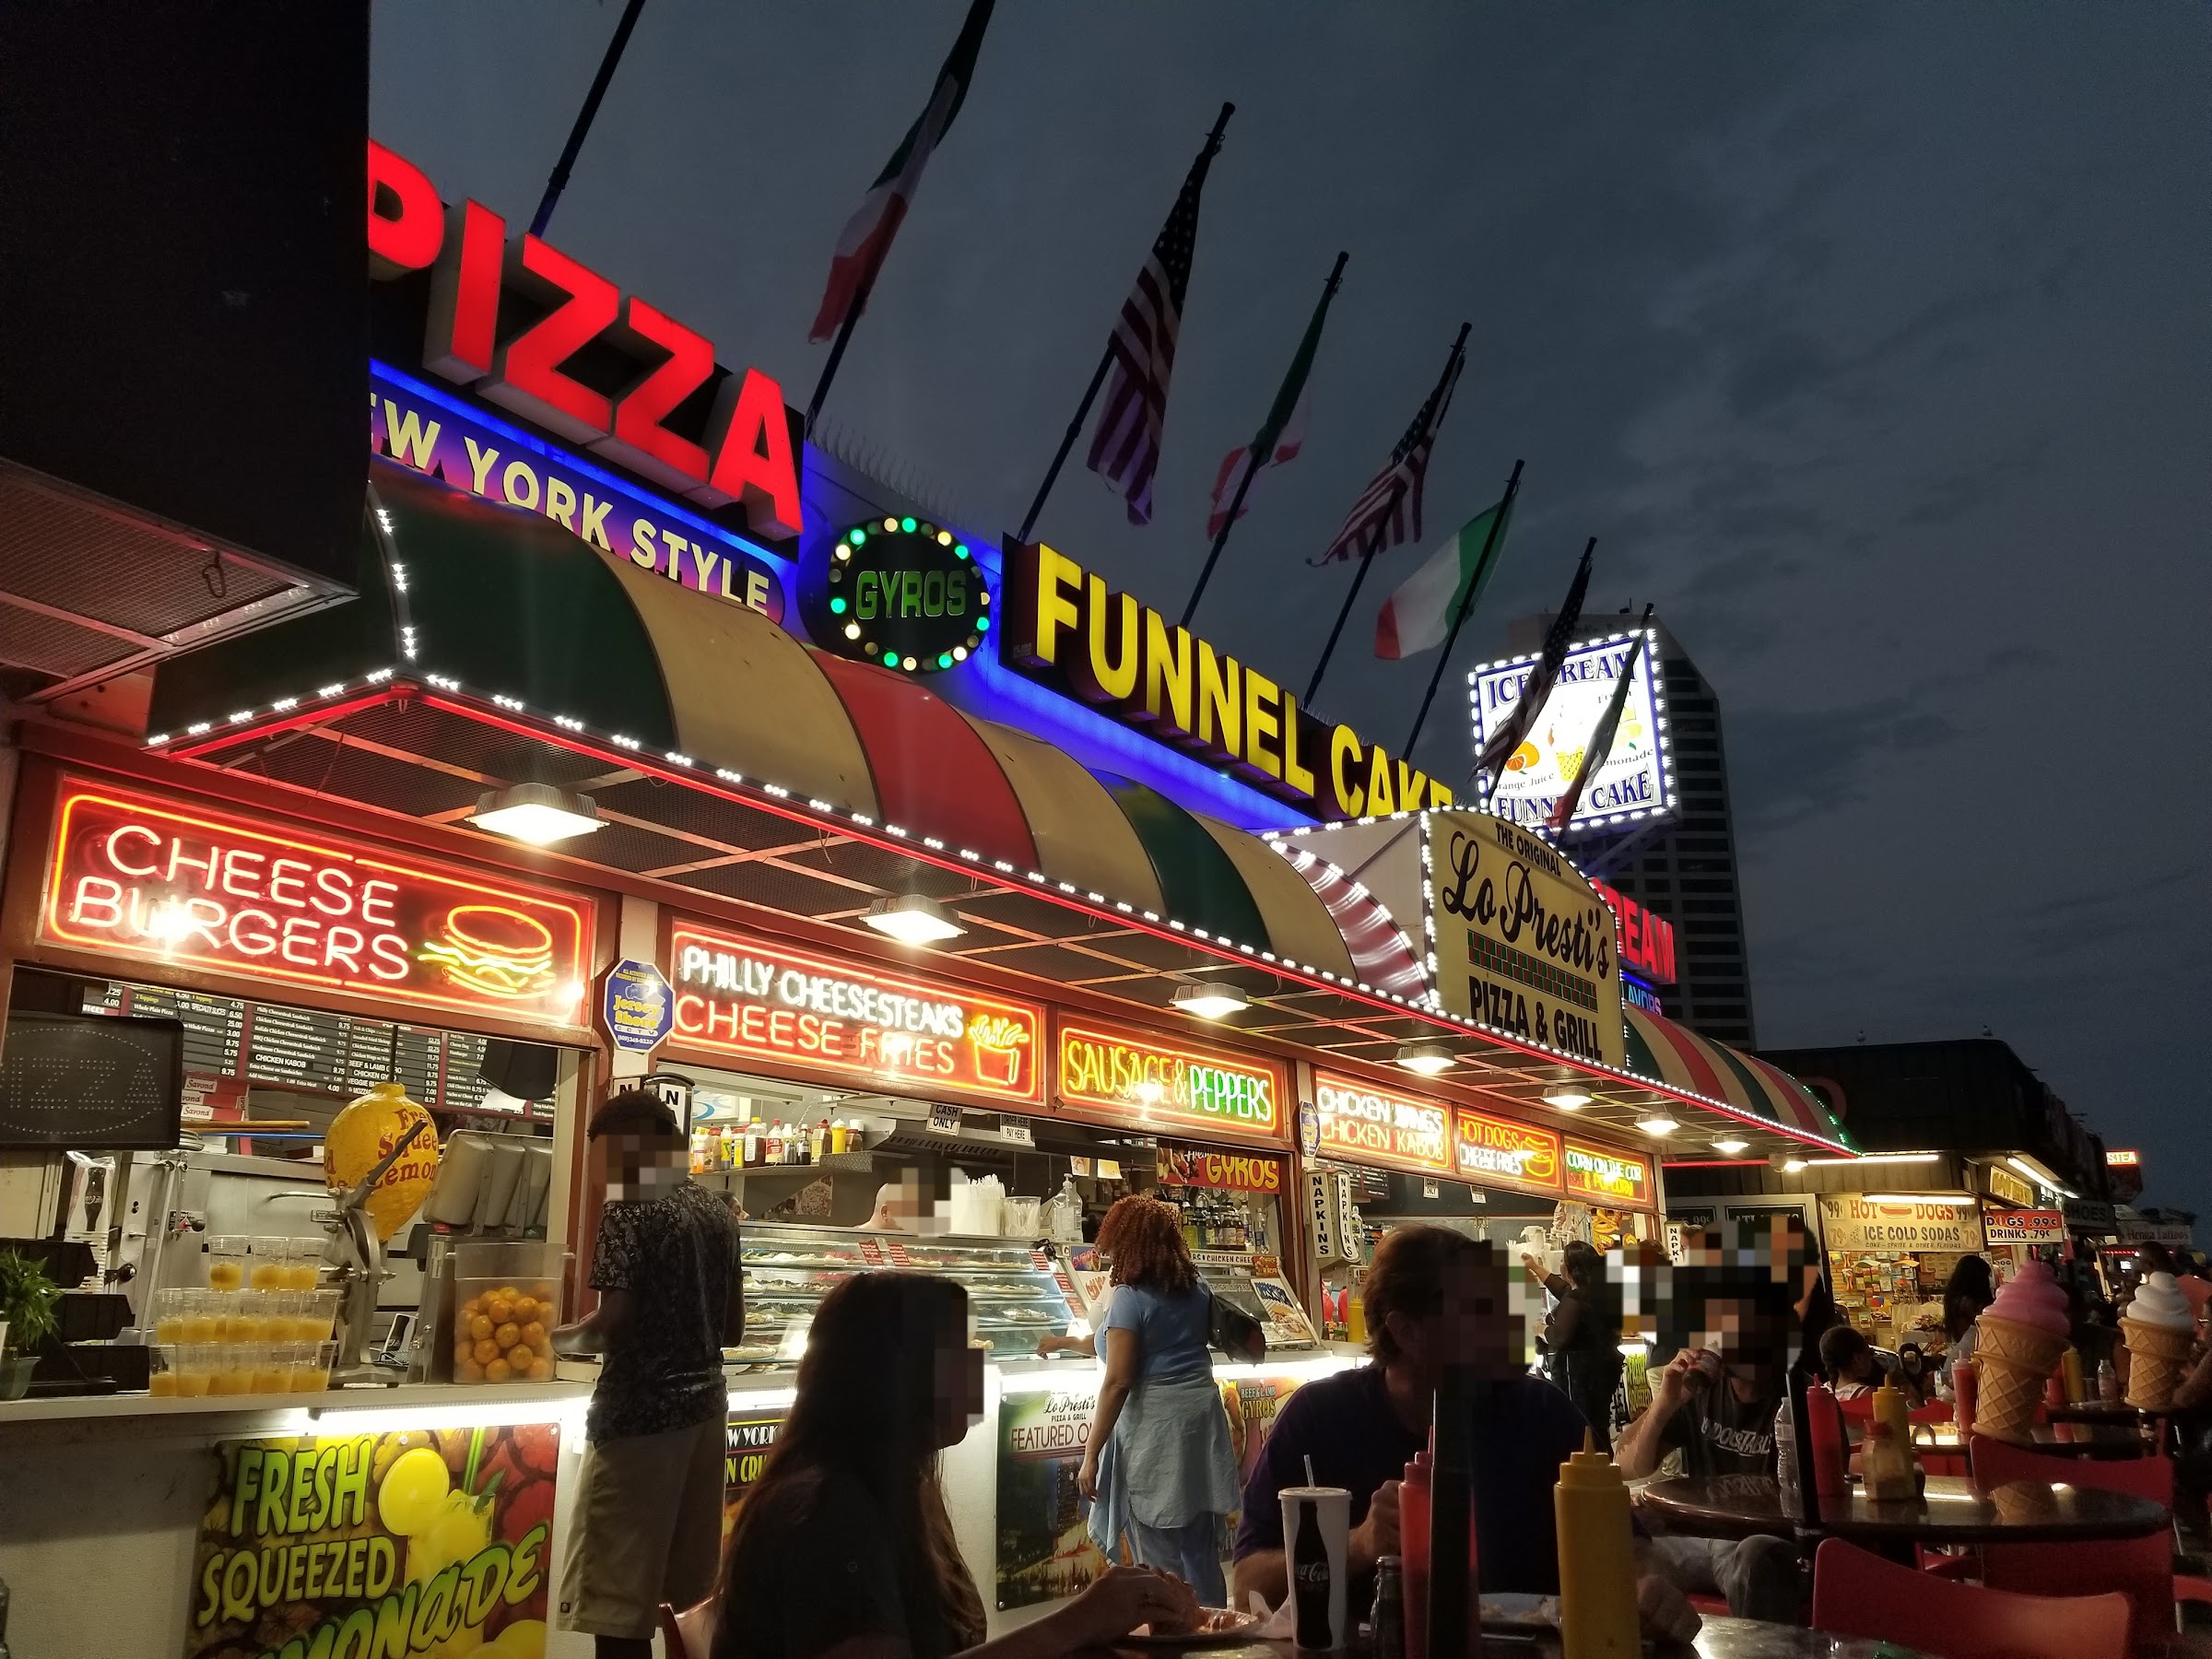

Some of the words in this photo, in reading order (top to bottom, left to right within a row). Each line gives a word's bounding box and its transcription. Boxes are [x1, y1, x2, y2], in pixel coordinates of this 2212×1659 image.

[368, 137, 803, 533] PIZZA
[371, 392, 441, 470] W
[463, 436, 611, 551] YORK
[630, 517, 770, 616] STYLE
[855, 570, 967, 620] GYROS
[1036, 542, 1314, 797] FUNNEL
[1554, 650, 1639, 688] REAM
[1497, 781, 1525, 791] range
[1529, 772, 1554, 785] Juice
[1588, 763, 1654, 810] CAKE
[1495, 822, 1514, 850] THE
[1516, 834, 1561, 877] ORIGINAL
[105, 825, 400, 928] CHEESE
[1442, 830, 1497, 924] Lo
[1500, 861, 1609, 980] Presti's
[69, 876, 410, 980] BURGERS
[1591, 877, 1677, 984] REAM
[103, 998, 120, 1006] 4.00
[230, 1001, 244, 1009] 4.75
[681, 945, 776, 995] PHILLY
[781, 971, 963, 1038] CHEESESTEAKS
[229, 1010, 243, 1019] 6.50
[613, 994, 662, 1017] Jersey
[1468, 976, 1530, 1039] PIZZA
[1535, 1001, 1548, 1042] &
[1554, 1009, 1603, 1062] GRILL
[227, 1020, 243, 1029] 25.00
[615, 1010, 659, 1030] Shore
[225, 1039, 240, 1047] 9.75
[226, 1030, 241, 1038] 3.00
[675, 994, 843, 1056] CHEESE
[860, 1029, 955, 1074] FRIES
[223, 1049, 238, 1057] 5.75
[255, 1053, 284, 1065] CHICKEN
[285, 1059, 307, 1068] KABOB
[0, 1057, 164, 1111] IZZA
[347, 1077, 369, 1087] VEGGIE
[353, 1069, 380, 1078] CHICKEN
[1067, 1040, 1171, 1105] SAUSAGE
[1173, 1058, 1188, 1105] &
[1189, 1065, 1272, 1122] PEPPERS
[327, 1084, 340, 1092] 4.00
[933, 1117, 956, 1130] ONLY
[935, 1105, 959, 1117] CASH
[1316, 1086, 1391, 1123] CHICKEN
[1394, 1103, 1443, 1135] WINGS
[1006, 1127, 1015, 1136] PAY
[1015, 1129, 1026, 1139] HERE
[1319, 1118, 1390, 1150] CHICKEN
[1396, 1129, 1443, 1160] KABOB
[1459, 1120, 1483, 1144] HOT
[1485, 1126, 1520, 1151] DOGS
[1206, 1154, 1279, 1190] GYROS
[1567, 1150, 1593, 1173] CORN
[1594, 1156, 1606, 1176] ON
[1625, 1162, 1641, 1181] COB
[1426, 1186, 1437, 1195] ONLY
[1594, 1172, 1634, 1197] POPCORN
[1312, 1175, 1329, 1255] NAPKINS
[1340, 1177, 1353, 1256] NAPKINS
[1849, 1199, 1877, 1219] HOT
[1915, 1204, 1954, 1221] DOGS
[1864, 1226, 1884, 1241] ICE
[1887, 1226, 1918, 1241] COLD
[1921, 1227, 1960, 1241] SODAS
[1990, 1229, 2027, 1240] DRINKS
[1042, 1396, 1058, 1414] Lo
[1059, 1395, 1096, 1413] Presti's
[1073, 1413, 1087, 1421] GRILL
[1241, 1398, 1277, 1420] GYROS
[743, 1425, 779, 1446] YORK
[1011, 1424, 1075, 1451] FEATURED
[1077, 1422, 1092, 1444] O
[230, 1439, 372, 1538] FRESH
[197, 1535, 396, 1628] SQUEEZED
